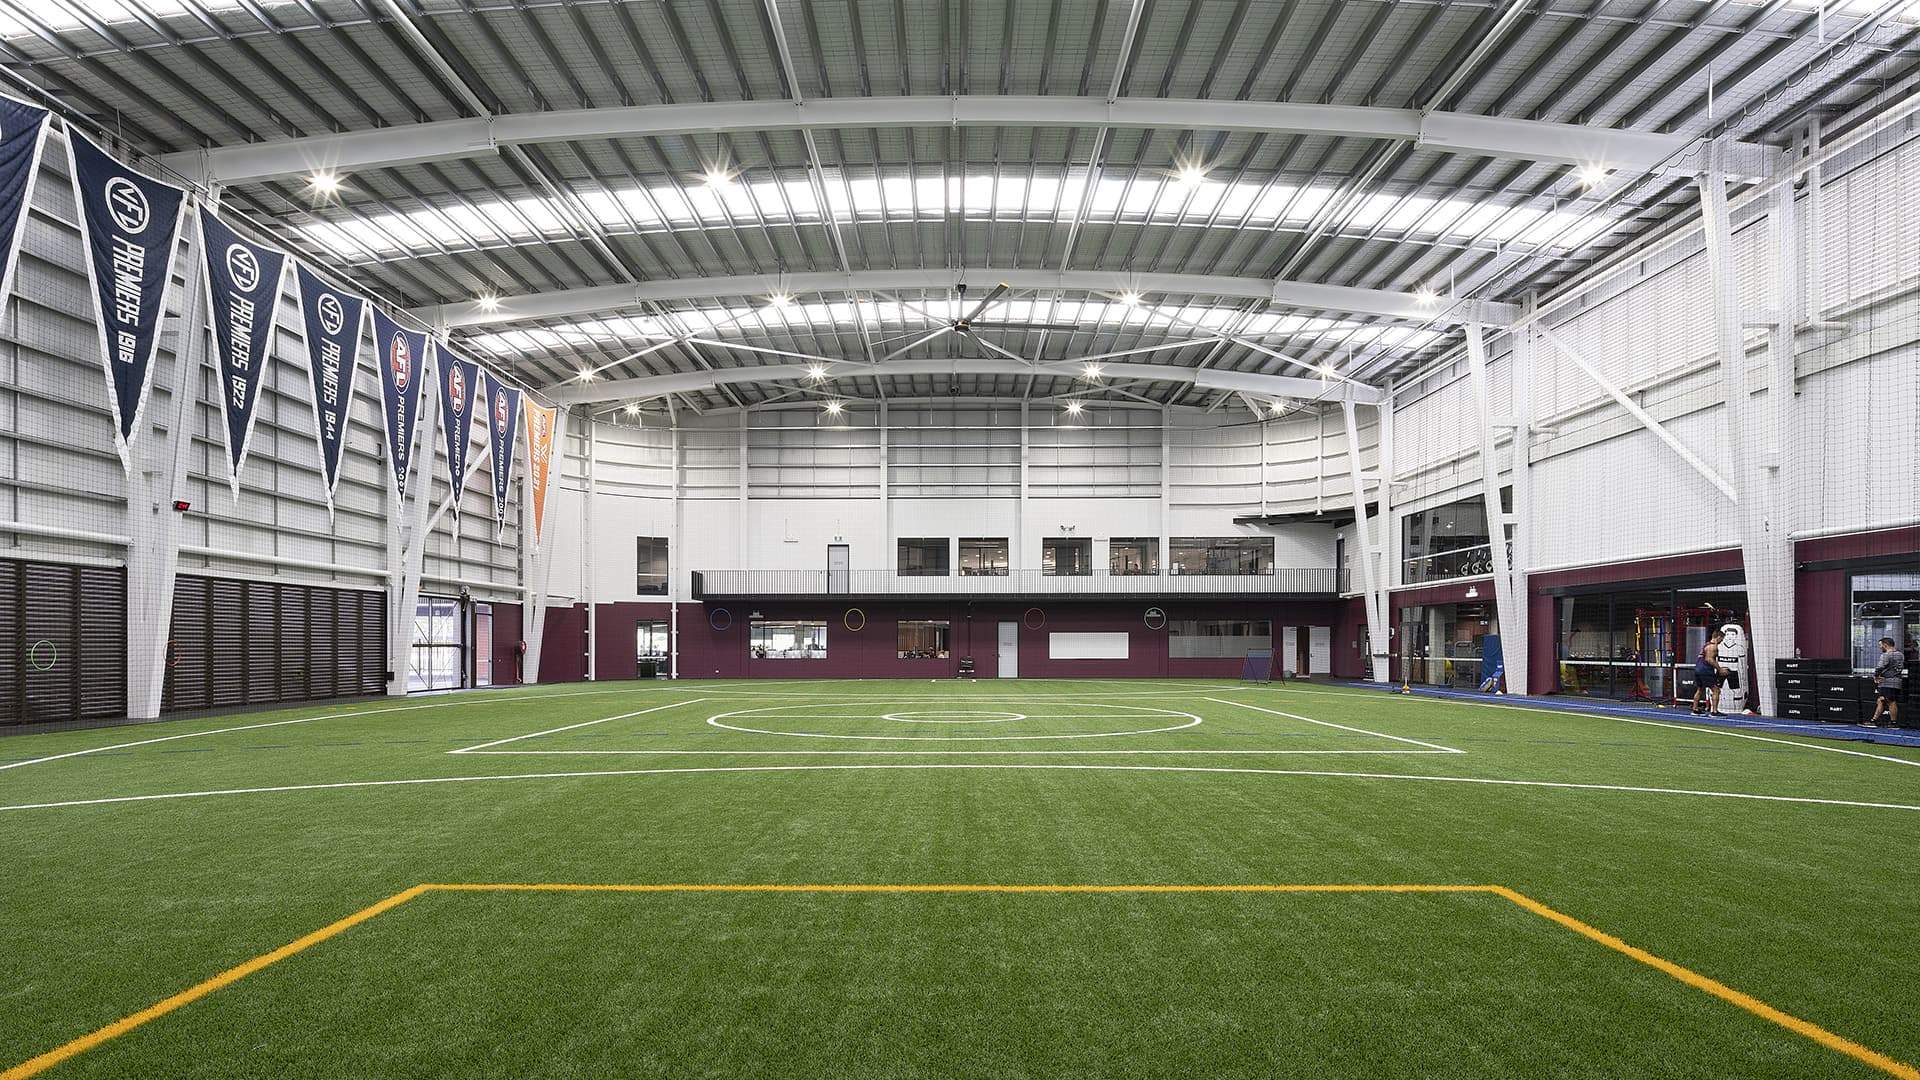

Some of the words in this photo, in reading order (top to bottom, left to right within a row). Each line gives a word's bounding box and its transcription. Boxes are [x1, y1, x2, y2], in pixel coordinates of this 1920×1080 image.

[112, 187, 144, 227] VFL
[112, 233, 145, 326] PREMIERS
[231, 253, 255, 286] VFL
[229, 290, 255, 371] PREMIERS
[322, 300, 340, 329] VFL
[118, 330, 137, 364] 1916
[395, 335, 408, 389] AFL
[231, 375, 247, 409] 1922
[321, 337, 341, 406] PREMIERS
[452, 365, 463, 412] AFL
[325, 410, 336, 440] 1944
[397, 395, 405, 461] PREMIERS
[498, 391, 506, 432] AFL
[533, 408, 542, 463] PREMIERS
